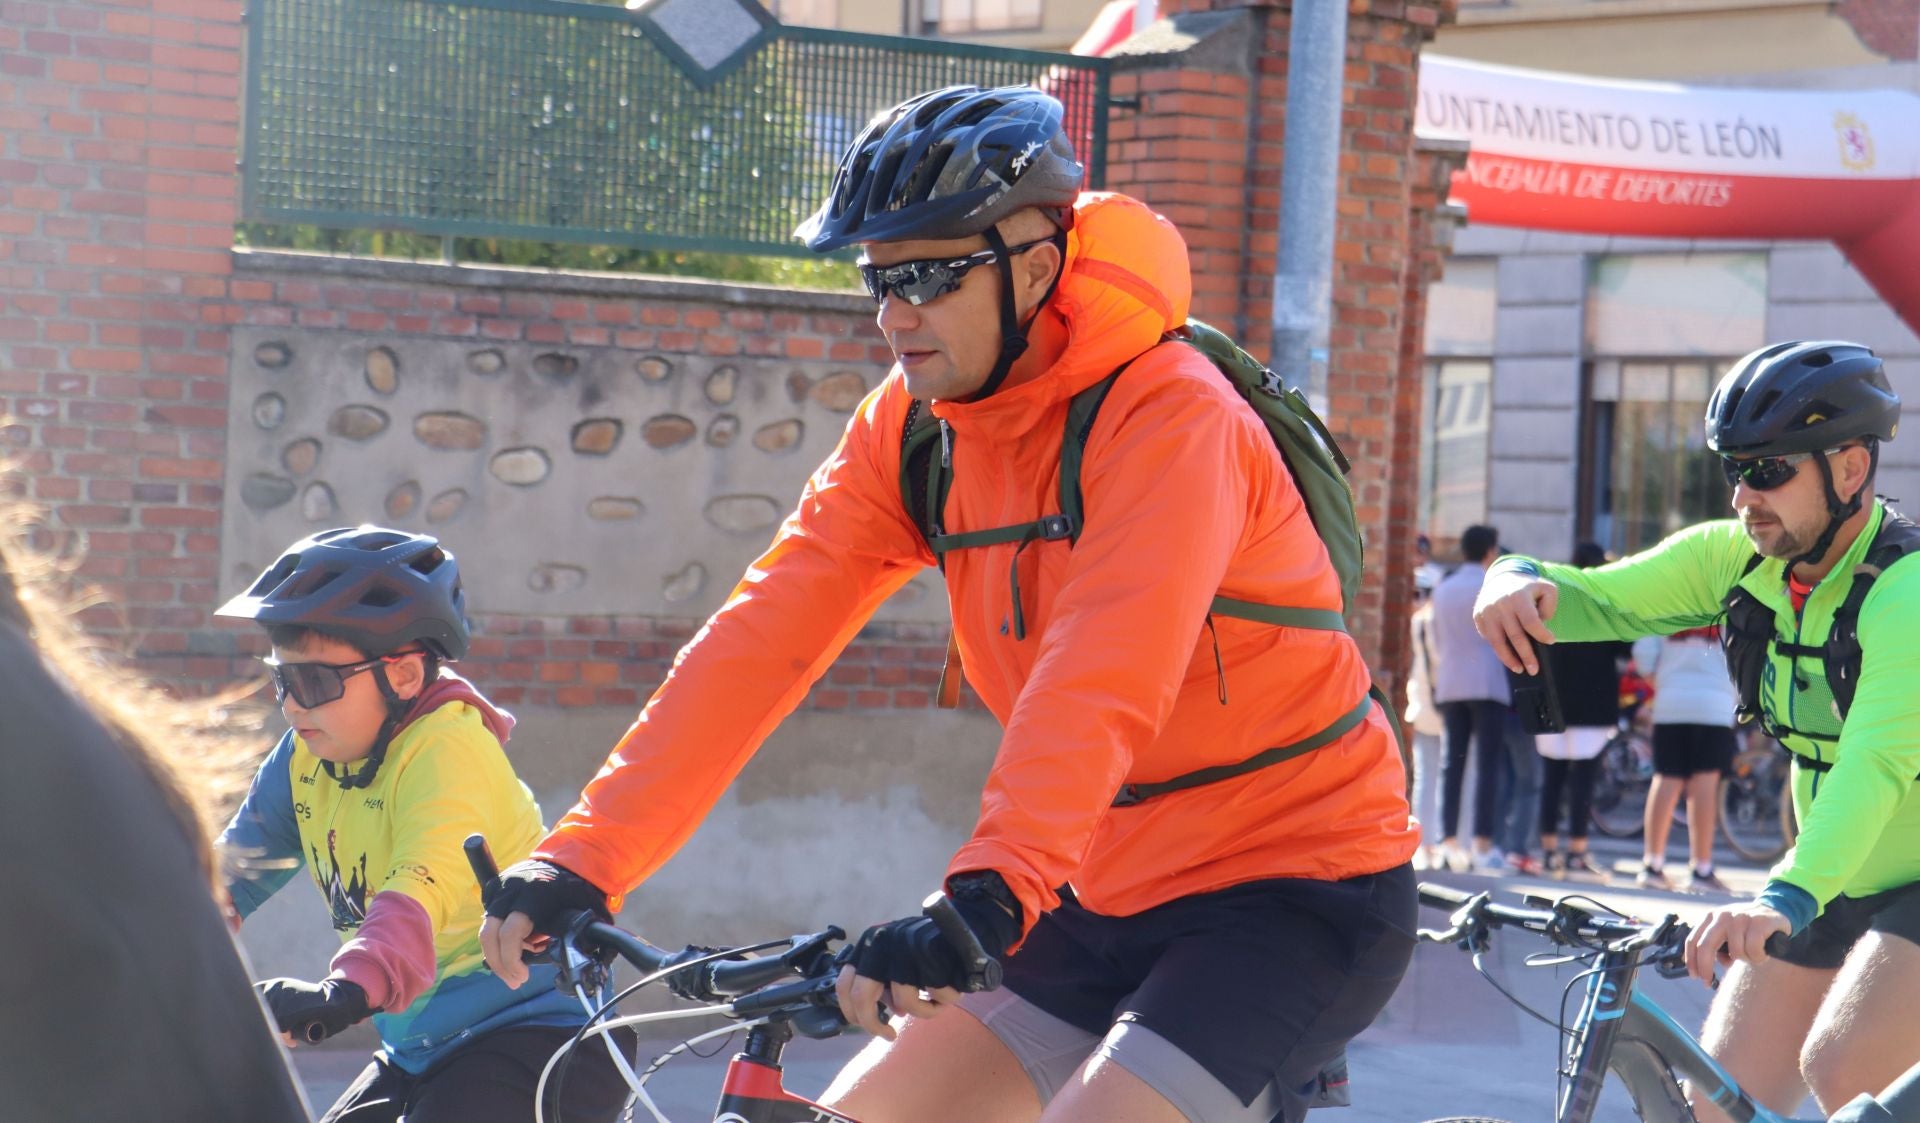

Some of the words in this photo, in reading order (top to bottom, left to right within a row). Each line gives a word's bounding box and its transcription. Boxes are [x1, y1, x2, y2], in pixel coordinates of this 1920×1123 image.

[1649, 117, 1692, 156] DE
[1699, 113, 1784, 160] LEÓN
[1570, 167, 1614, 200] DE
[1611, 170, 1735, 208] DEPORTES
